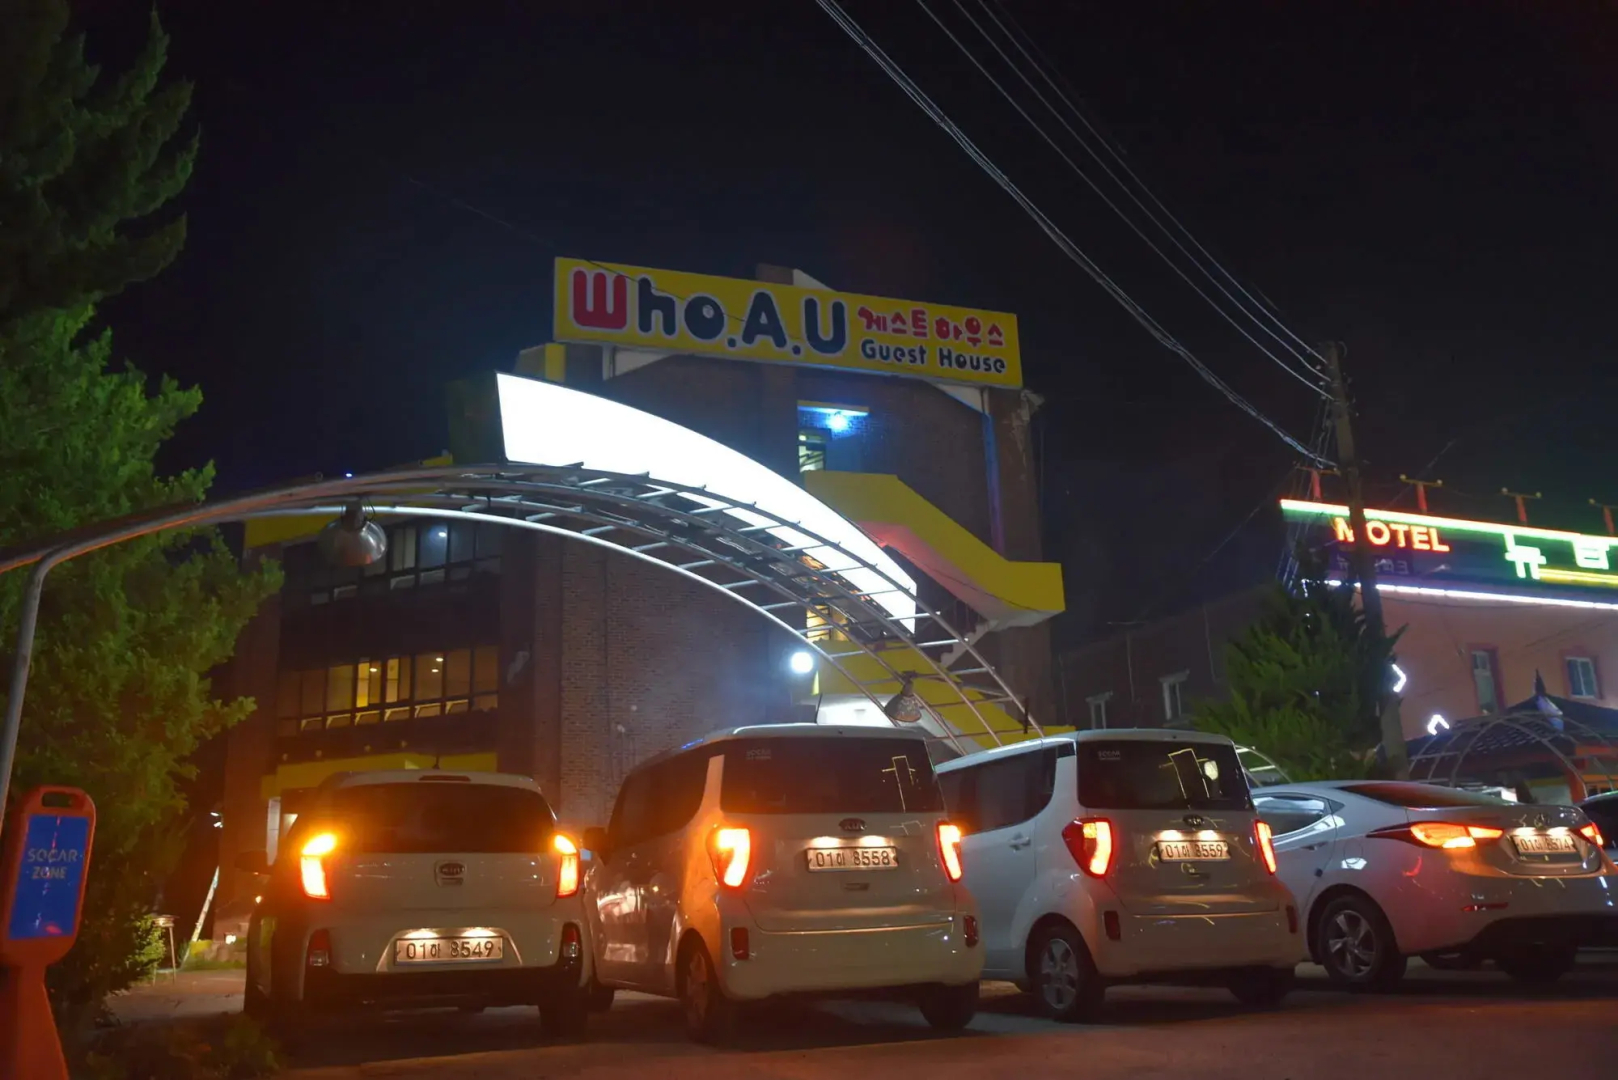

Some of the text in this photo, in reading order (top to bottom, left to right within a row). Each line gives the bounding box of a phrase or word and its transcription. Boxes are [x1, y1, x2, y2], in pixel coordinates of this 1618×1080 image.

[935, 316, 1004, 347] 하우스
[861, 338, 1006, 374] Guest House
[27, 848, 78, 863] SOCAR
[853, 850, 890, 866] 8558
[1194, 843, 1223, 858] 8559
[32, 865, 67, 880] ZONE
[450, 940, 494, 958] 8549
